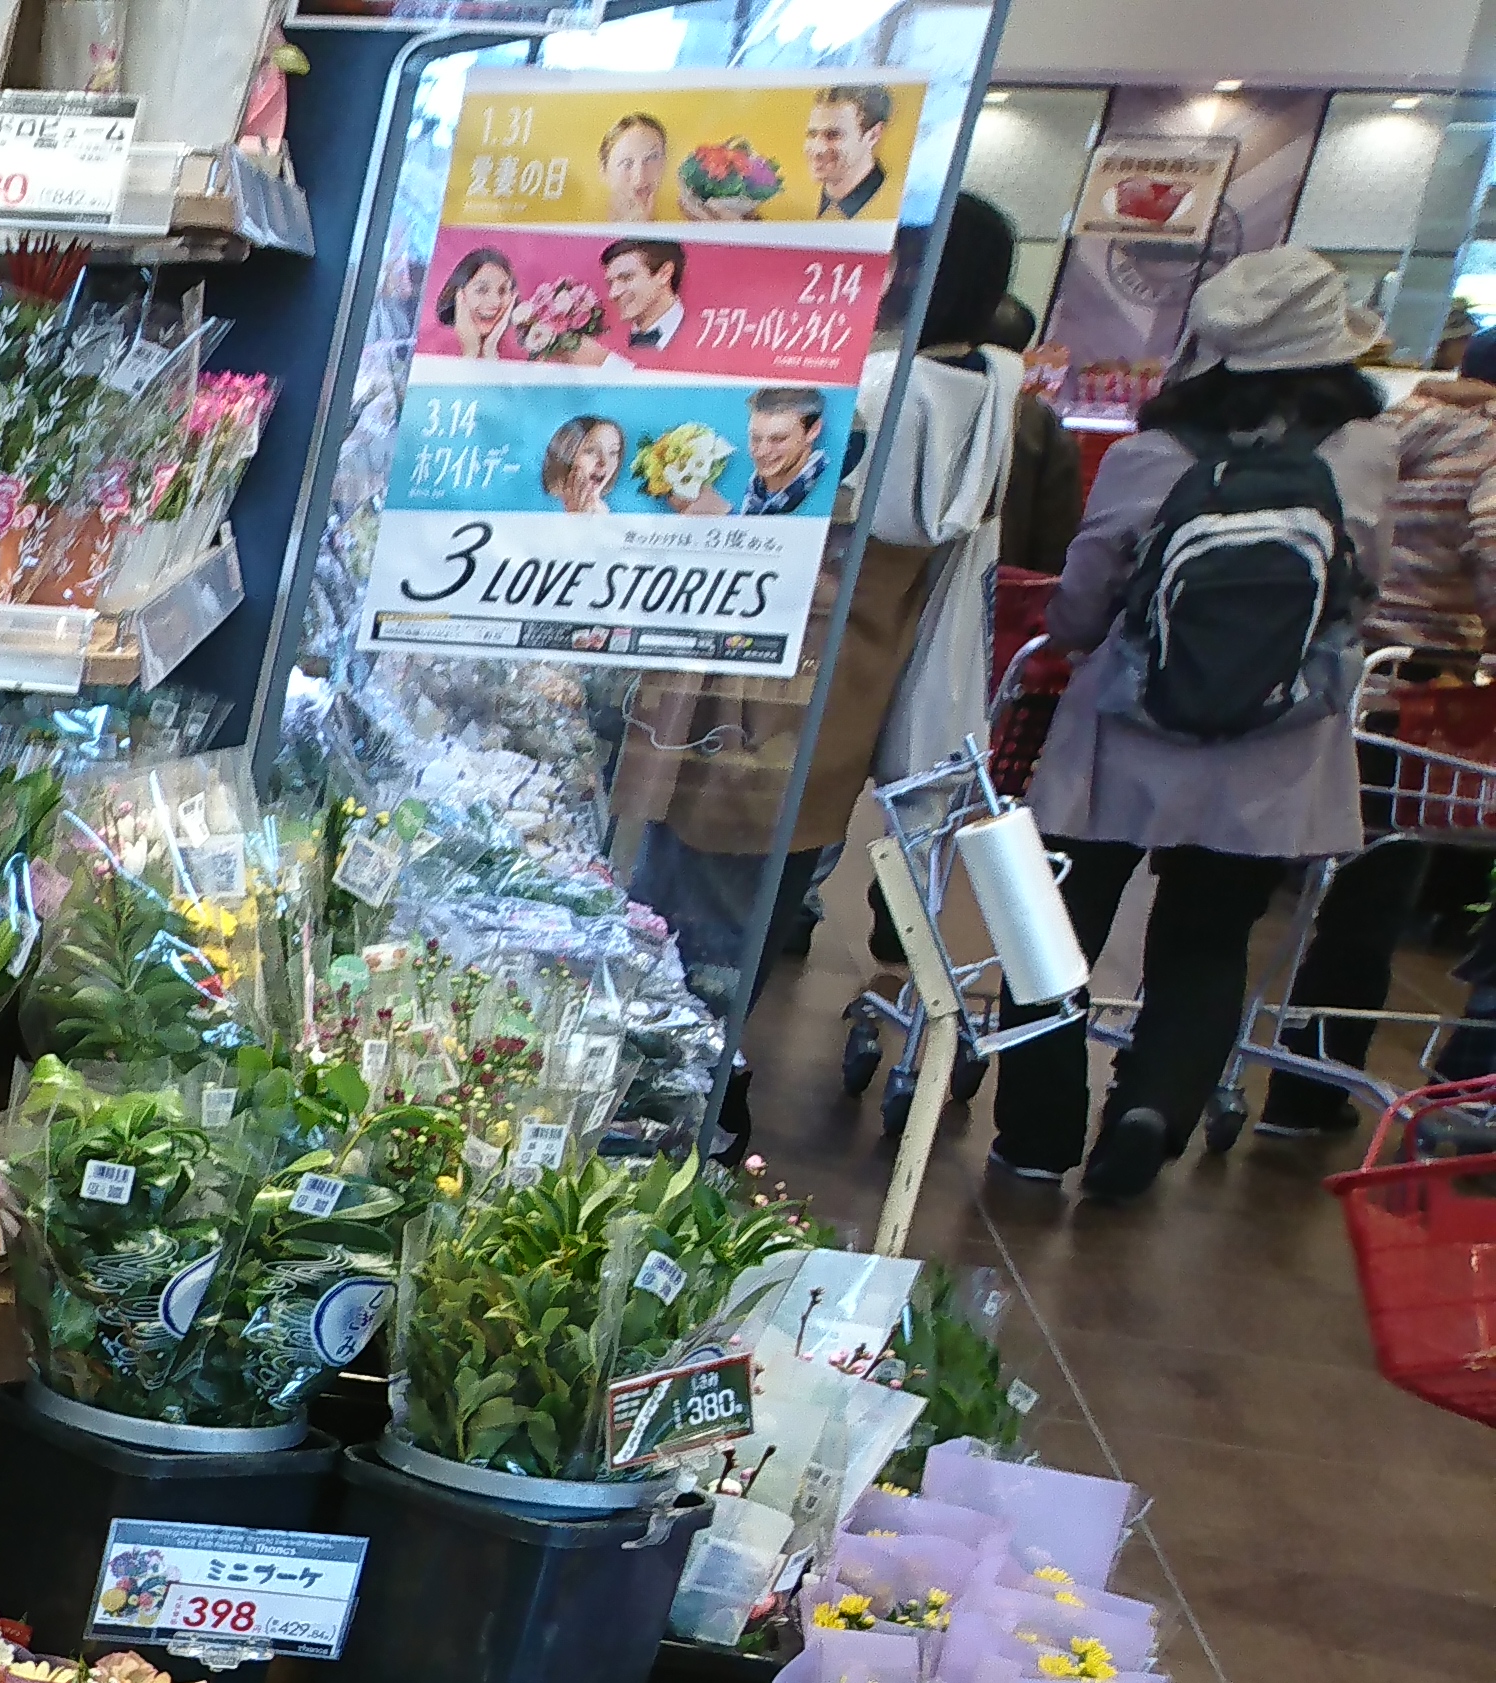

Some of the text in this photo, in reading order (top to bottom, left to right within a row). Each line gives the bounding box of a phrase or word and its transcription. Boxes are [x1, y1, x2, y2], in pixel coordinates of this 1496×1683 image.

[480, 106, 536, 147] 1.31
[803, 264, 864, 307] 2.14
[421, 398, 478, 439] 3.14
[410, 443, 522, 492] ホワイトデー
[399, 520, 780, 619] 3 LOVE STORIES
[687, 1388, 735, 1426] 380
[182, 1595, 258, 1633] 398
